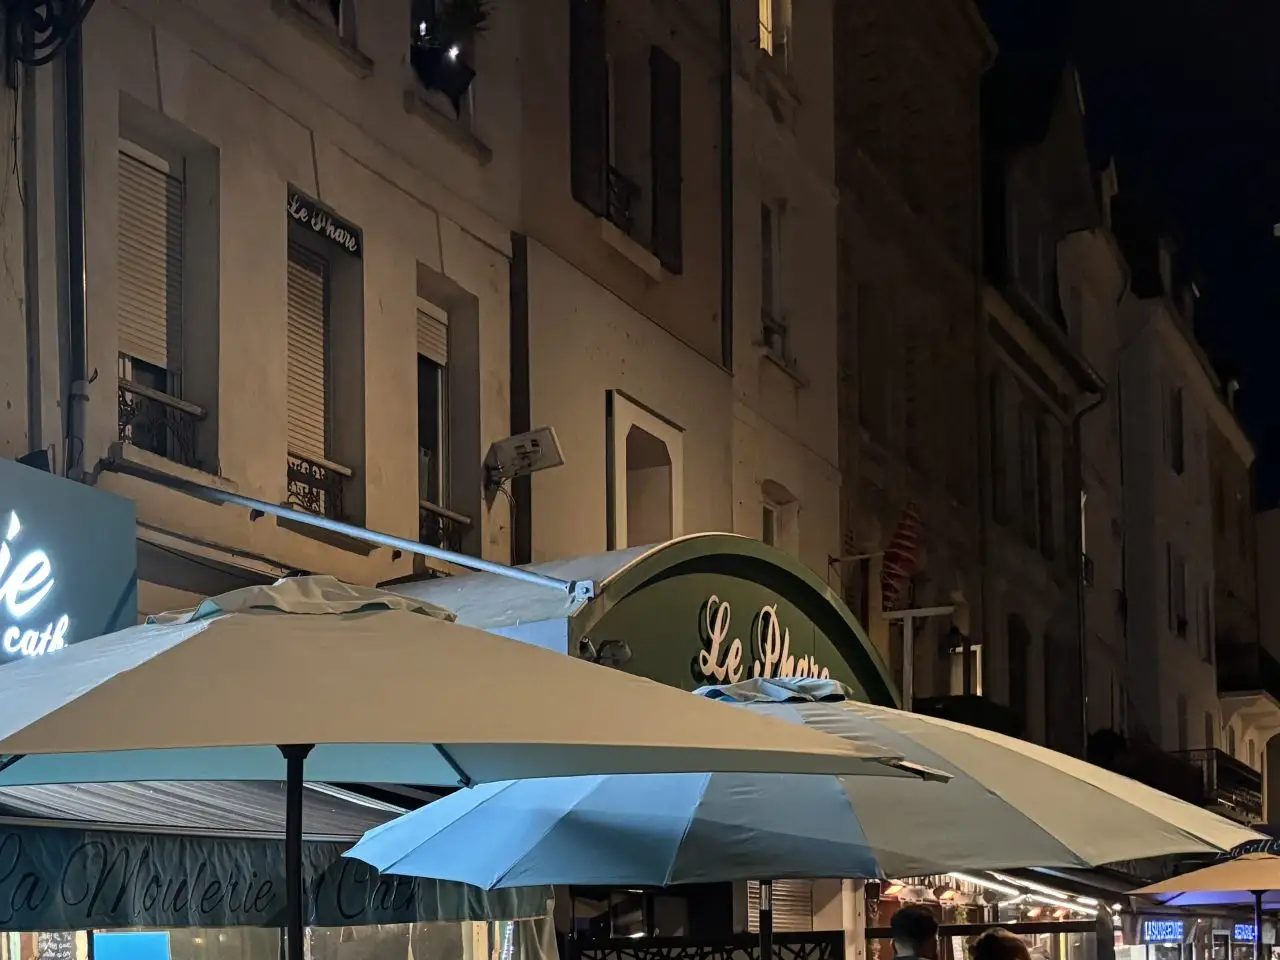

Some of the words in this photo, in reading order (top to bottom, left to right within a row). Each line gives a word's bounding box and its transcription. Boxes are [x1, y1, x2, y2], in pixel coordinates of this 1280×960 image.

[287, 194, 309, 222] Le
[699, 594, 744, 684] Le
[61, 841, 277, 919] Moulerie
